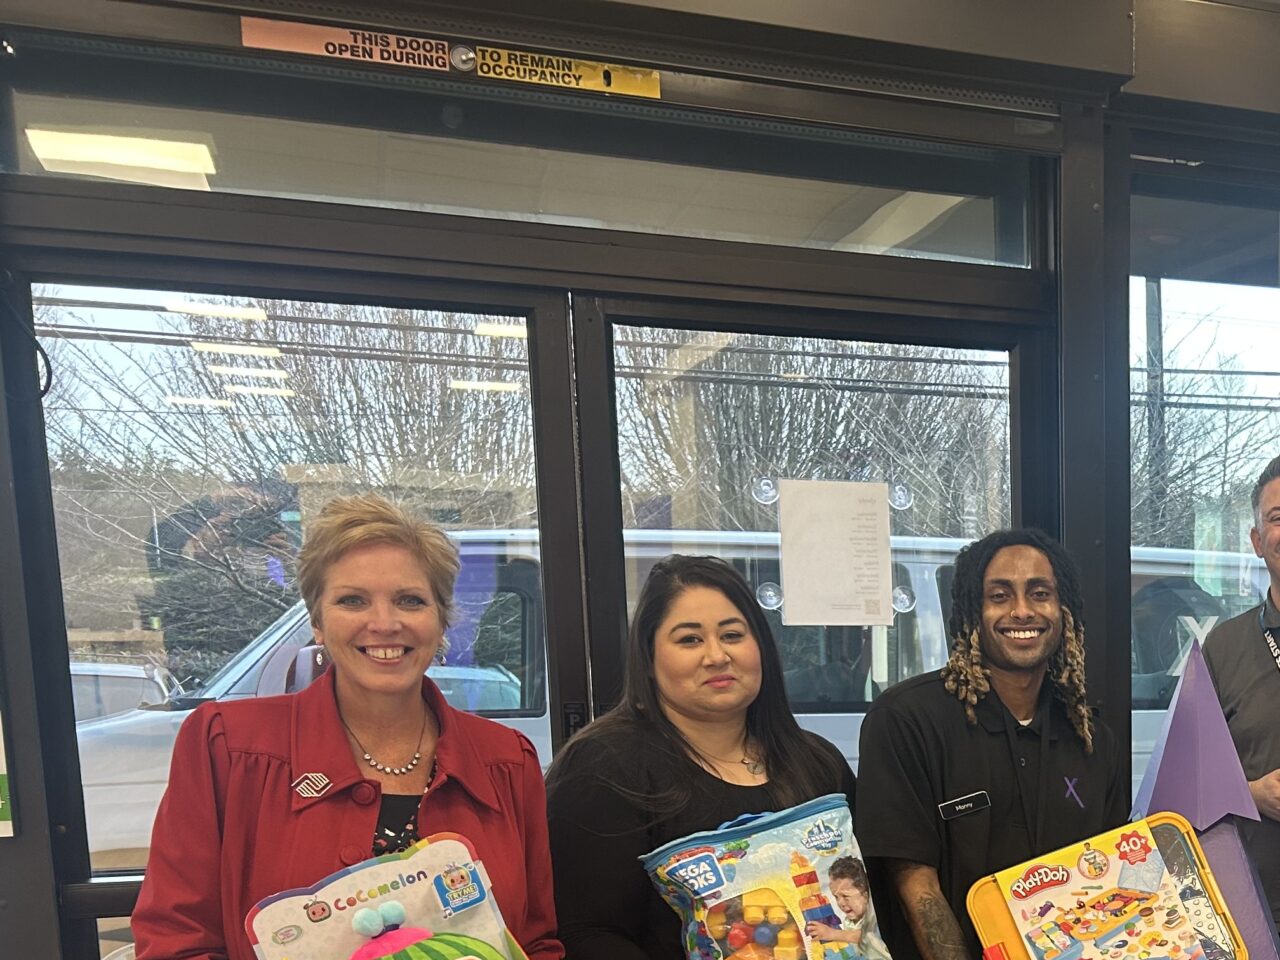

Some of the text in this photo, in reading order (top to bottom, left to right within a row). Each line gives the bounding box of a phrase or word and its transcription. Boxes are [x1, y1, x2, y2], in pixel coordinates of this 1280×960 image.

[324, 41, 447, 69] OPEN DURING
[349, 31, 446, 55] THIS DOOR
[478, 48, 573, 72] TO REMAIN
[479, 62, 583, 86] OCCUPANCY
[1264, 630, 1280, 658] START
[1119, 837, 1147, 854] 40+
[334, 869, 428, 911] CoComelon
[1011, 865, 1068, 897] Play-Doh
